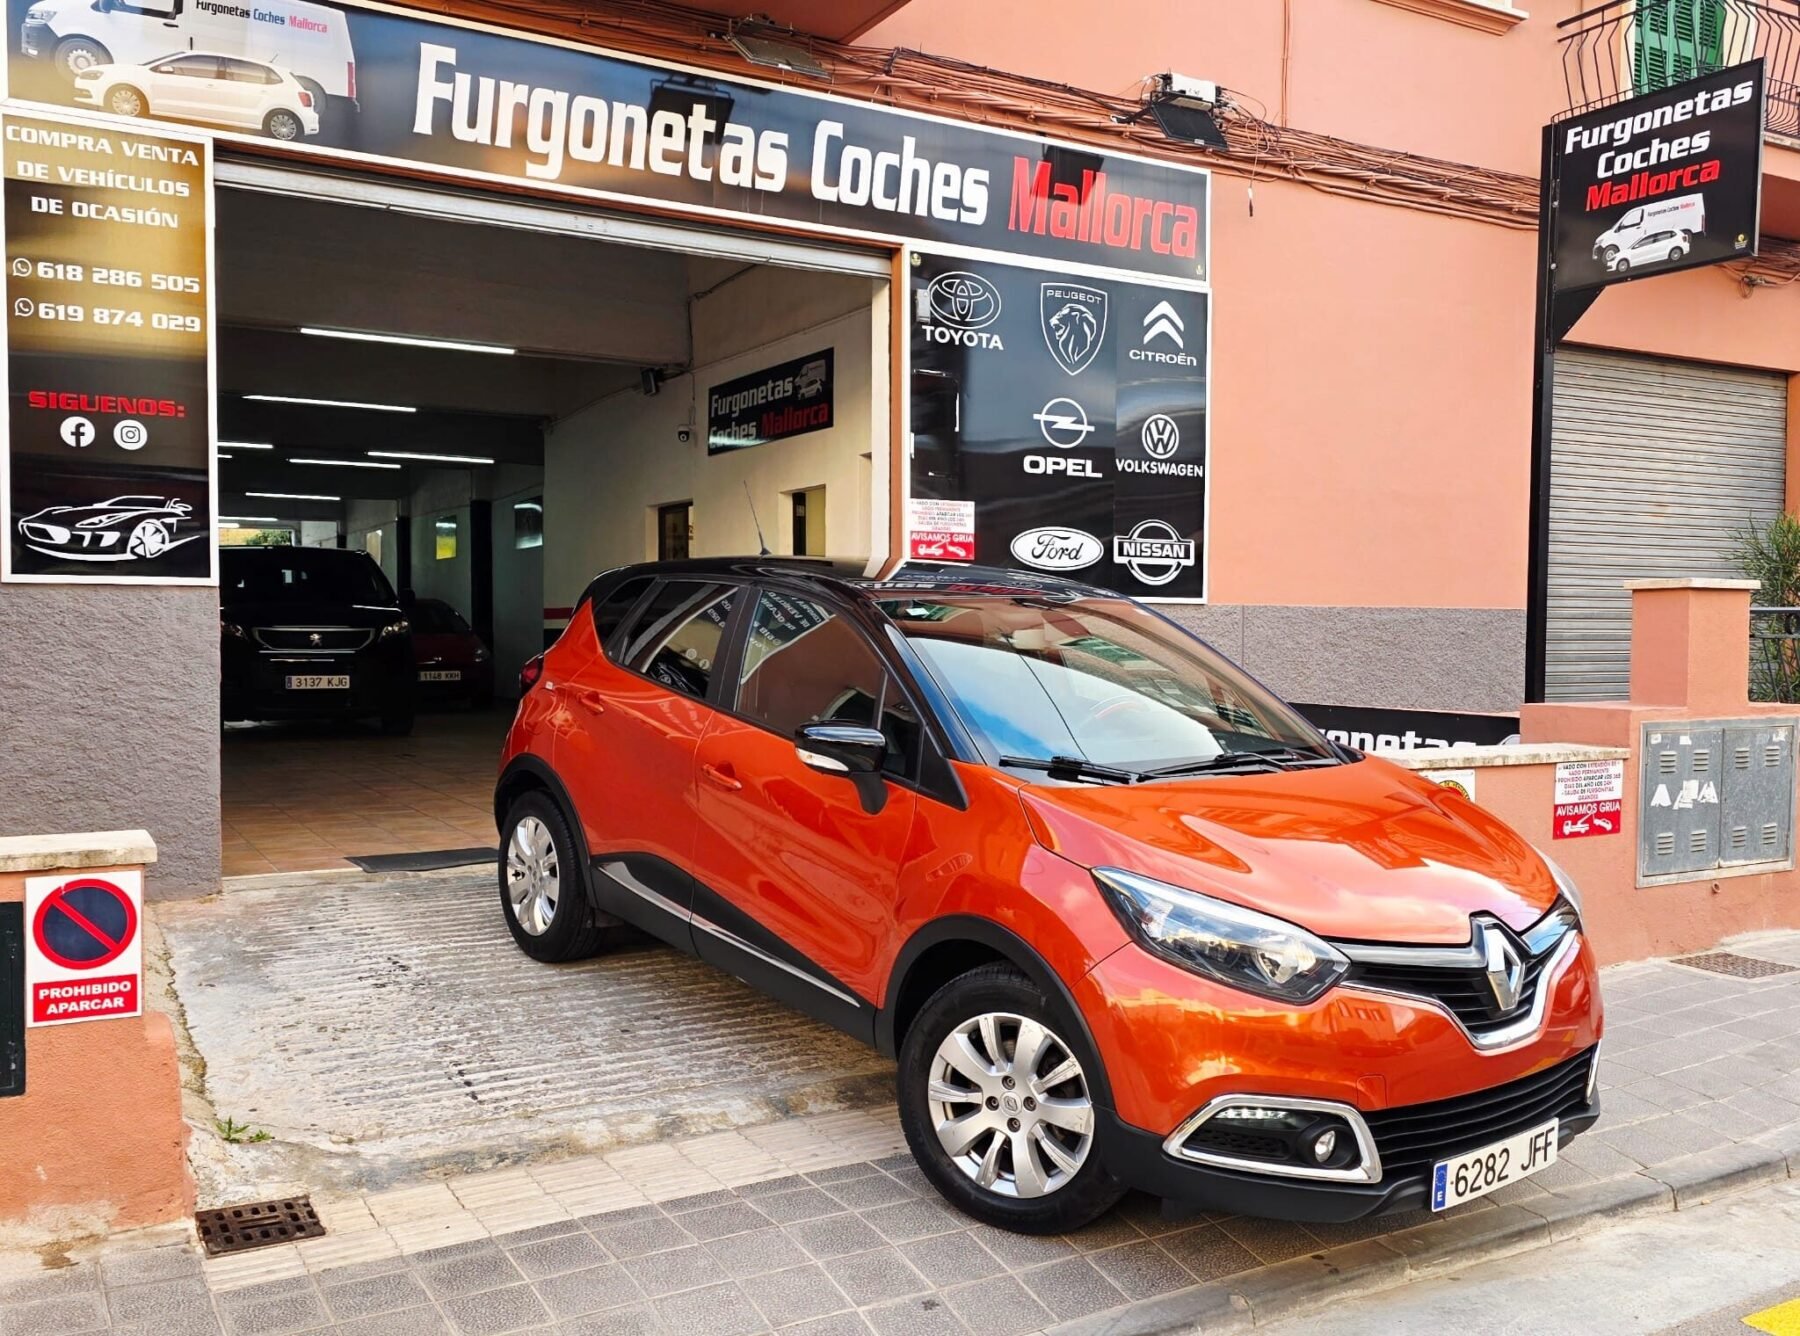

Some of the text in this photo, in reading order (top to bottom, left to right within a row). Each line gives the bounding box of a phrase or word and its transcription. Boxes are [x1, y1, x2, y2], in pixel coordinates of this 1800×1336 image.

[196, 0, 328, 33] Furgonetas Coches Mallorca
[1565, 80, 1754, 155] Furgonetas
[5, 125, 199, 167] COMPRA VENTA
[412, 42, 1199, 259] Furgonetas Coches Mallorca
[1597, 130, 1711, 179] Coches
[16, 160, 190, 198] DE VEHÍCULOS
[1585, 159, 1721, 212] Mallorca
[30, 196, 180, 229] DE OCASIÓN
[37, 261, 200, 293] 618 286 505
[1046, 289, 1102, 305] PEUGEOT
[38, 302, 201, 333] 619 874 029
[922, 324, 1004, 351] TOYOTA
[710, 376, 794, 418] Furgonetas
[709, 402, 829, 449] Coches Mallorca
[1023, 455, 1103, 478] OPEL
[1115, 458, 1203, 478] VOLKSWAGEN
[910, 532, 974, 543] AVISAMOS GRUA
[1031, 533, 1085, 561] Ford
[1122, 542, 1185, 559] NISSAN
[295, 676, 347, 687] 3137 KJG
[1556, 801, 1621, 817] AVISAMOS GRUA
[38, 981, 132, 1000] PROHIBIDO
[46, 997, 124, 1015] APARCAR
[1454, 1126, 1555, 1197] 6282 JFF
[1436, 1191, 1443, 1201] E
